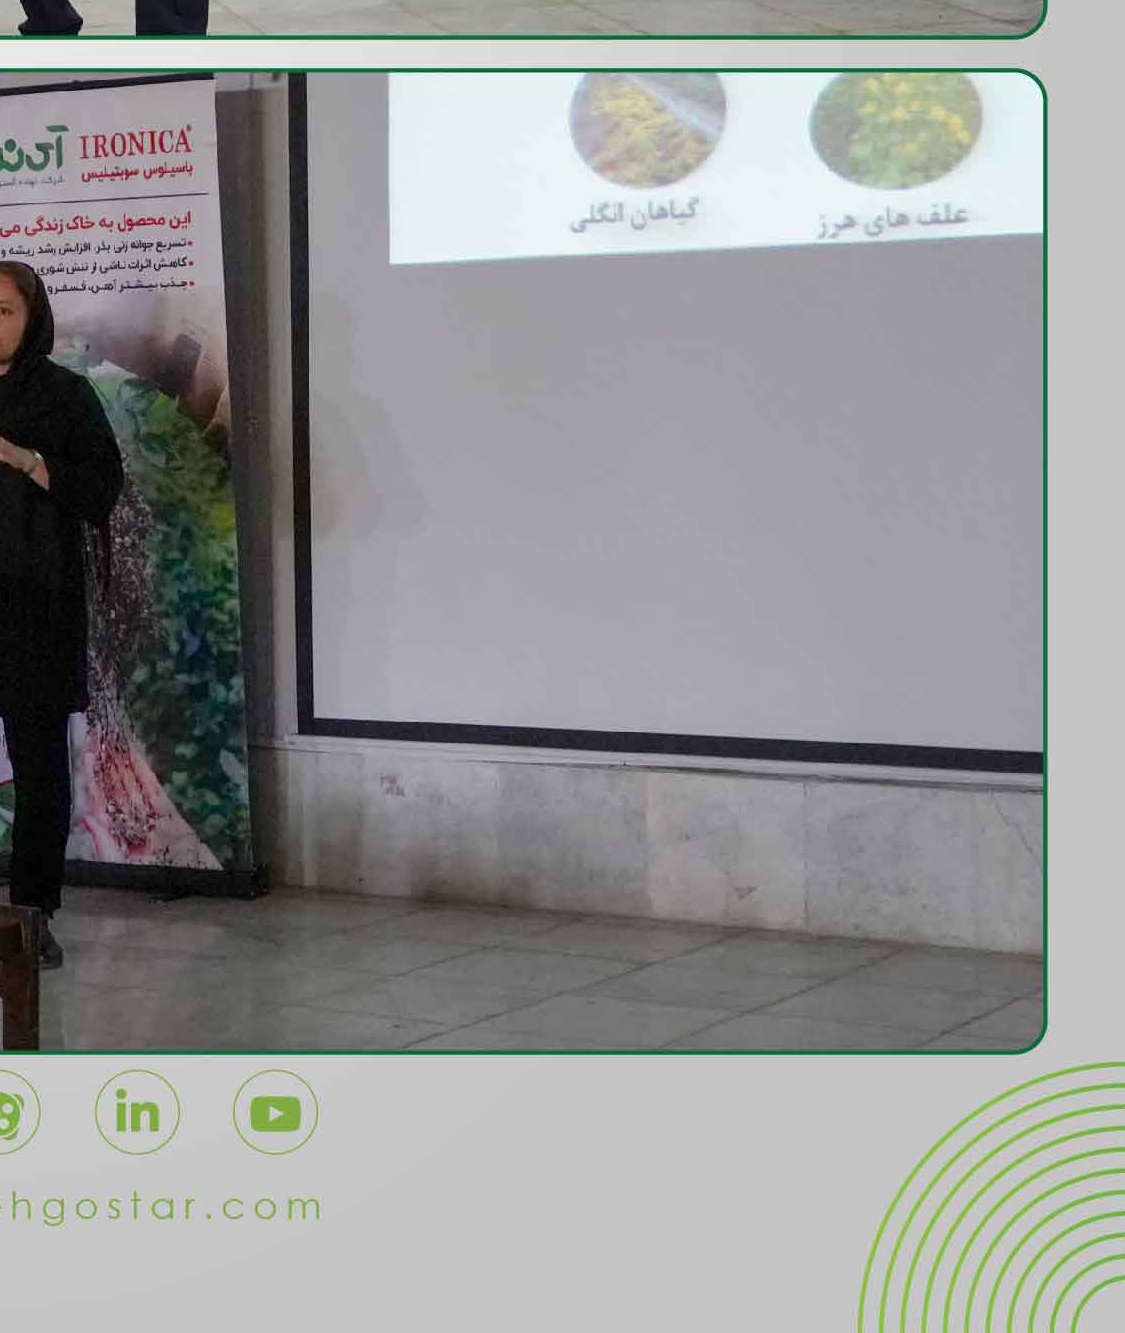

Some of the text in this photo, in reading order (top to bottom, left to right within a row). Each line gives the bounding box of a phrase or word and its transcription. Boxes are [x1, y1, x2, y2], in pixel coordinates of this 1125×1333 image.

[80, 128, 192, 160] IRONICA
[143, 161, 193, 179] باسیلوس
[25, 213, 64, 236] زندگی
[66, 214, 96, 230] خاک
[117, 213, 165, 232] محصول
[169, 211, 190, 230] این
[569, 196, 700, 234] گیاهان انگلی
[817, 201, 970, 240] علف های هرز
[0, 222, 21, 238] می
[99, 217, 114, 233] به
